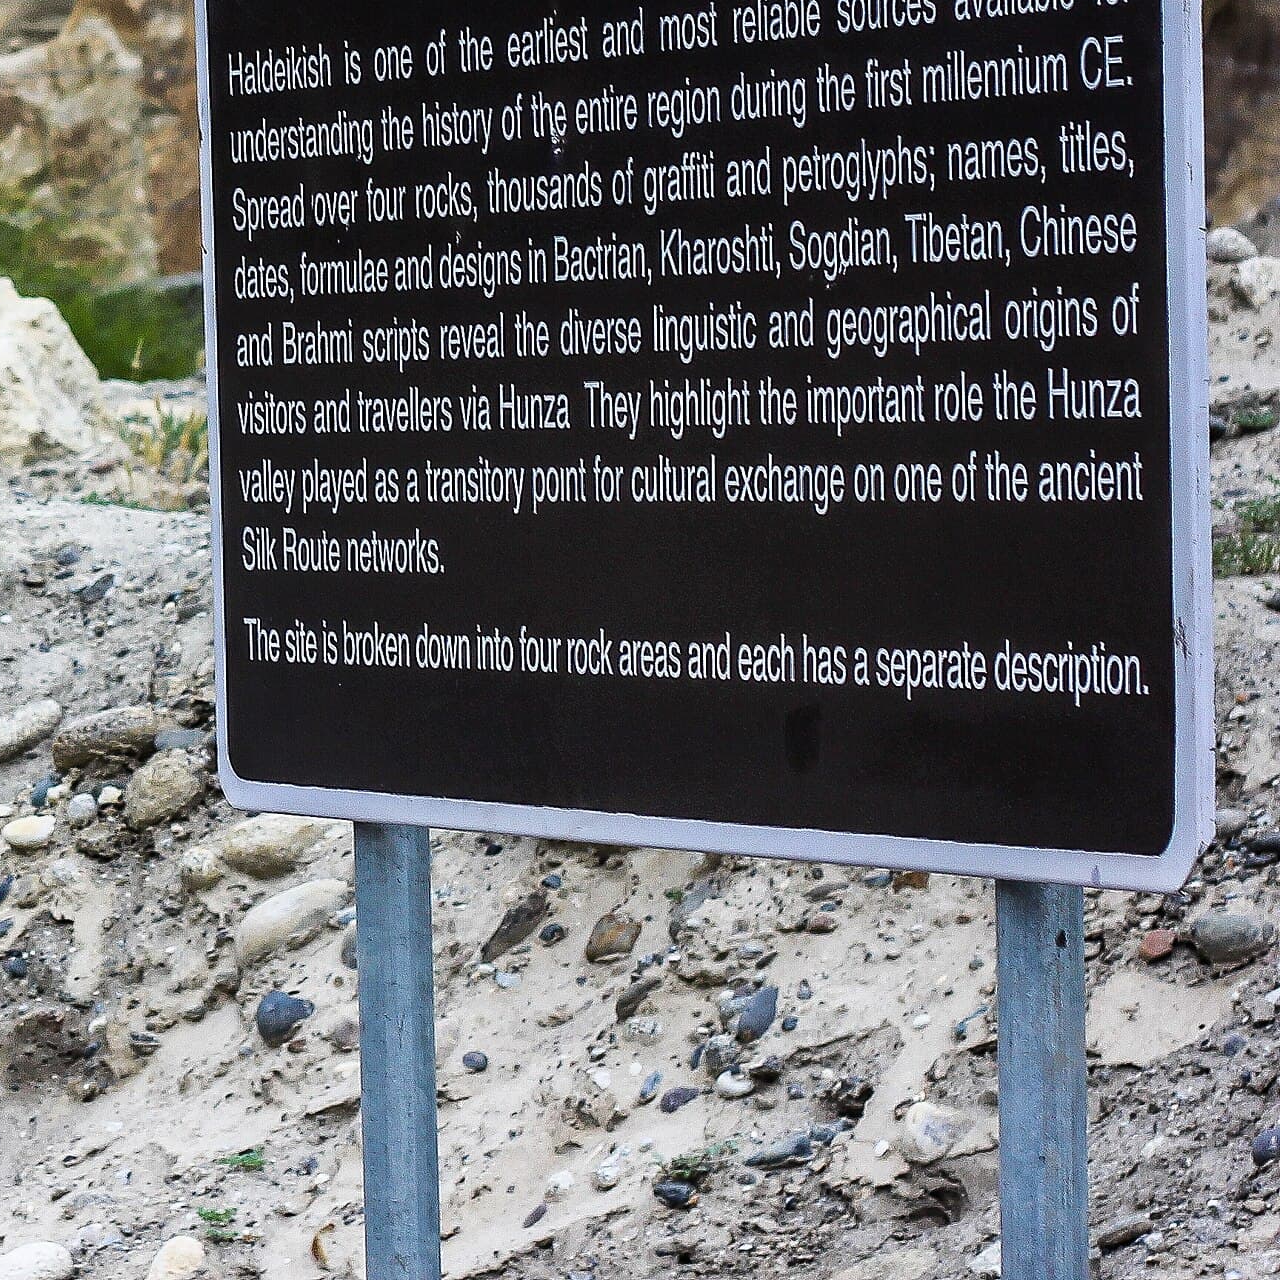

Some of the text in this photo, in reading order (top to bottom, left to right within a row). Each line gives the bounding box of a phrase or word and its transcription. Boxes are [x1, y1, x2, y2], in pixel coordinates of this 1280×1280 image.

[228, 43, 332, 97] Haldeikish
[343, 40, 362, 85] is
[374, 44, 414, 82] one
[426, 28, 447, 77] of
[458, 26, 494, 73] the
[507, 16, 589, 68] earliest
[602, 6, 645, 58] and
[659, 1, 718, 52] most
[230, 35, 1134, 165] understanding the history of the entire region during the first millennium CE.
[232, 119, 1134, 242] Spread over four rocks, thousands of graffiti and petroglyphs; names, titles,
[234, 204, 1137, 304] dates, formulae and designs in Bactrian, Kharoshti, Sogdian, Tibetan, Chinese
[236, 282, 1140, 373] and Brahmi scripts reveal the diverse linguistic and geographical origins of
[237, 367, 1142, 440] visitors and travellers via Hunza They highlight the important role the Hunza
[238, 448, 1144, 515] valley played as a transitory point for cultural exchange on one of the ancient
[242, 526, 445, 574] Silk Route networks.
[243, 617, 1150, 708] The site is broken down into four rock areas and each has a separate description.
